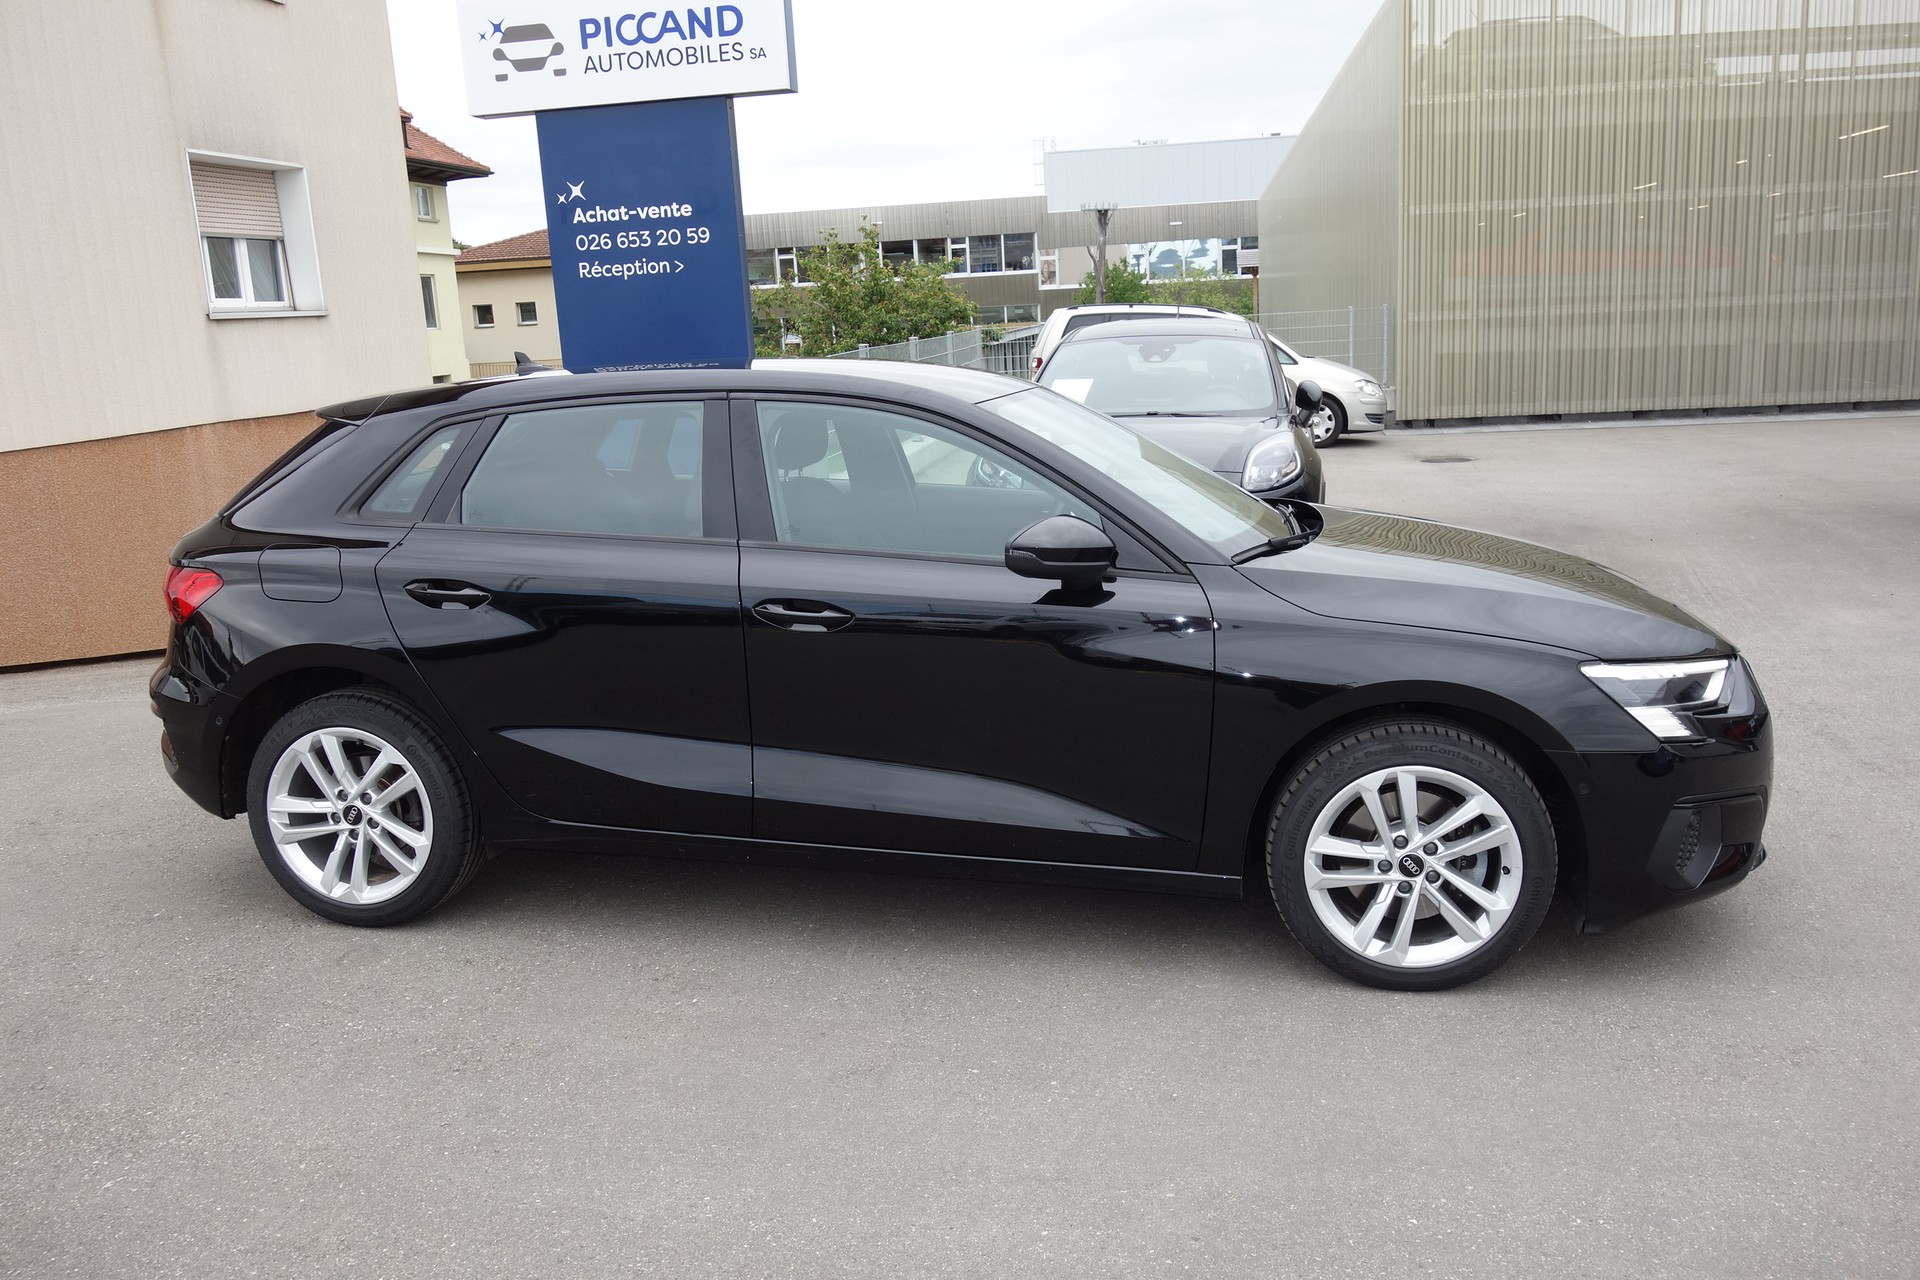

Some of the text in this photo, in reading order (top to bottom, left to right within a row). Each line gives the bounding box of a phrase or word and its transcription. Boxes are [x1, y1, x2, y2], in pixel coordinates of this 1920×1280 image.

[579, 4, 744, 50] PICCAND
[583, 42, 767, 74] AUTOMOBILES SA
[572, 202, 692, 224] Achat-vente
[575, 226, 710, 251] 026 653 20 59
[578, 257, 671, 280] Réception
[406, 744, 445, 801] Continental
[1282, 793, 1317, 860] Continental
[1507, 876, 1544, 941] Continental
